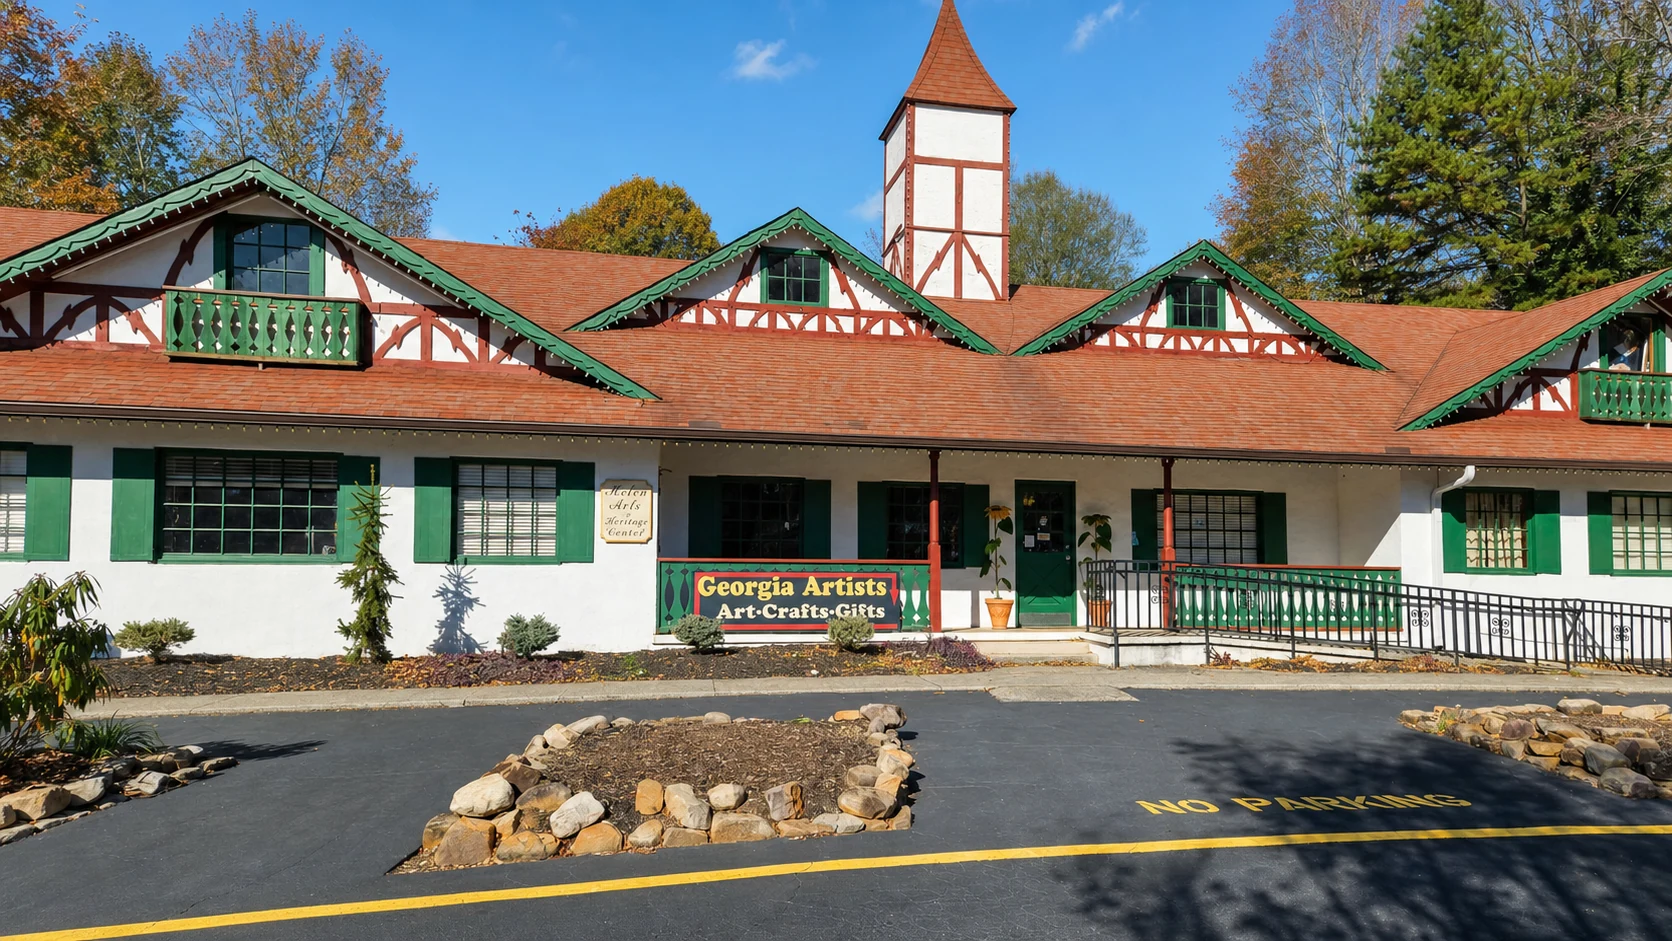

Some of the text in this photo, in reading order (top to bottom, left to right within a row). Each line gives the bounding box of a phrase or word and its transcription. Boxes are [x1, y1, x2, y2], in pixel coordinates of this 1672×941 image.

[605, 485, 647, 497] Helen
[609, 499, 641, 510] Arts
[605, 516, 648, 528] Heritage
[606, 528, 645, 537] Center
[697, 575, 887, 601] Georgia Artists
[1136, 794, 1473, 815] NO PARKING
